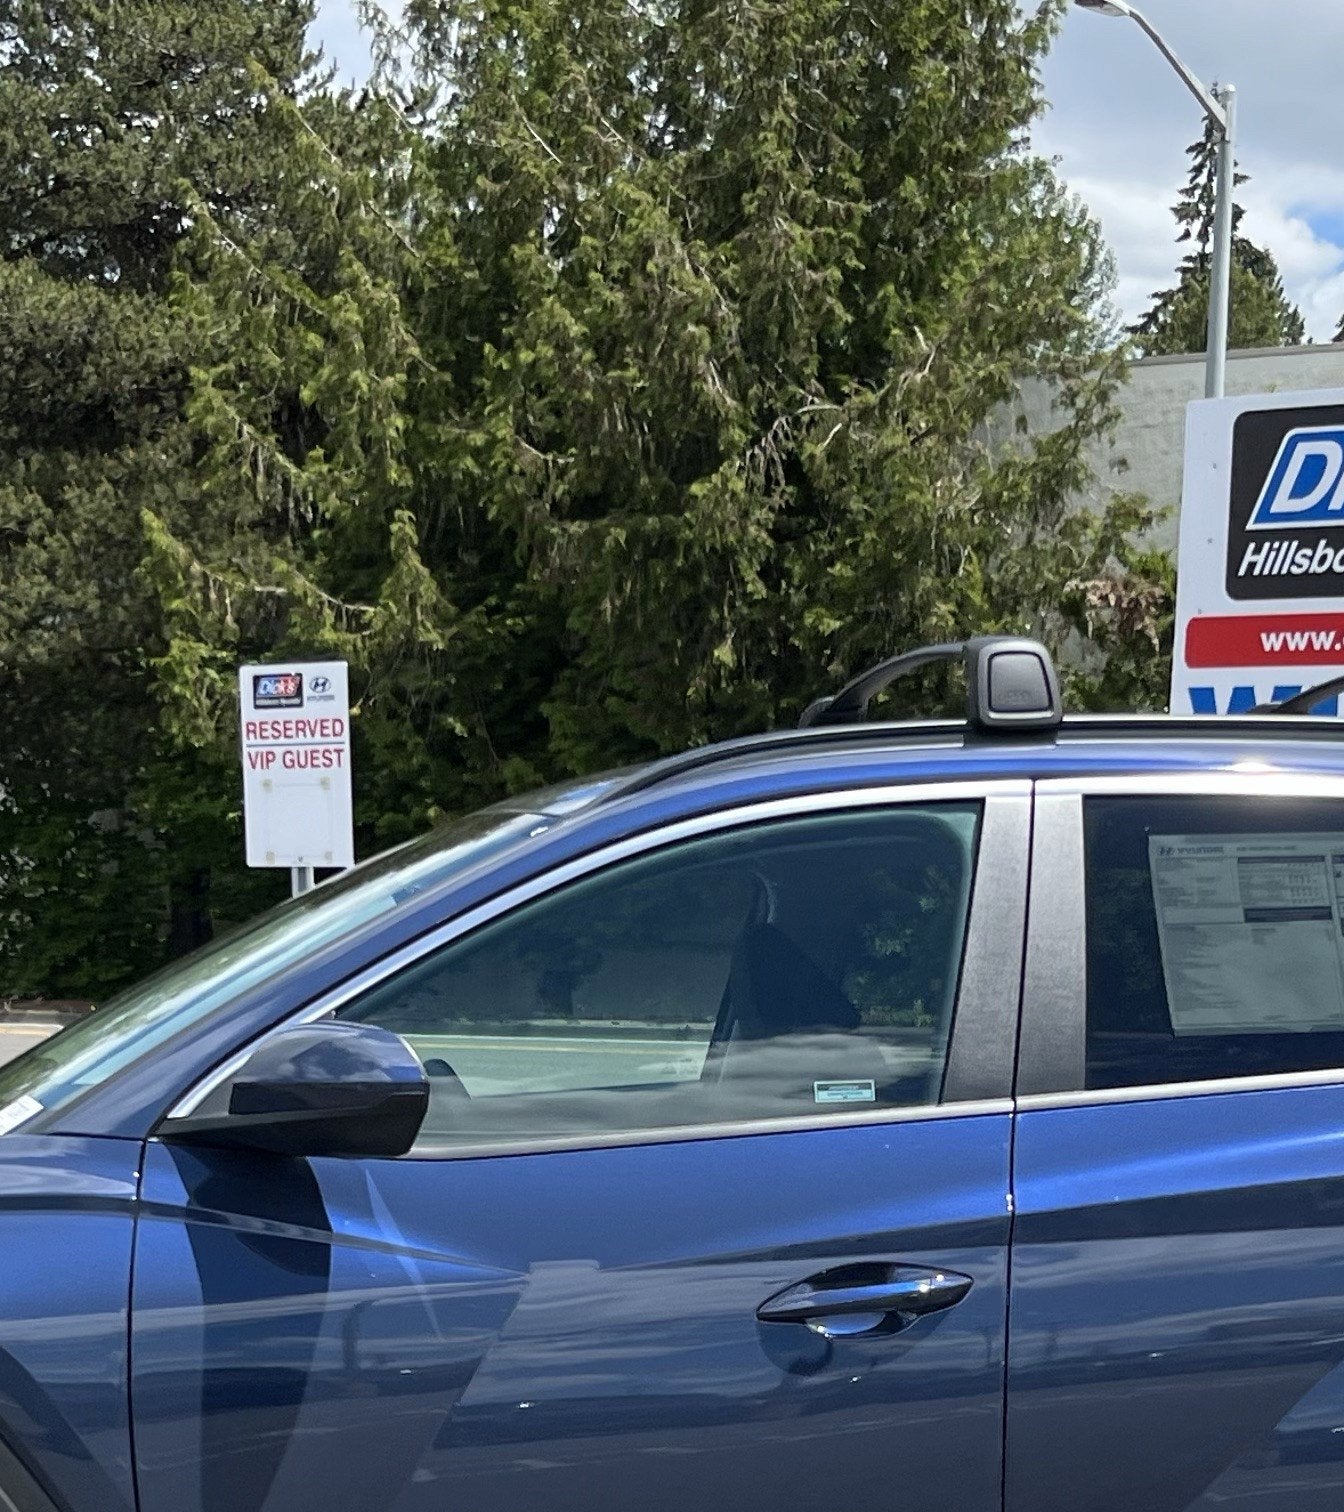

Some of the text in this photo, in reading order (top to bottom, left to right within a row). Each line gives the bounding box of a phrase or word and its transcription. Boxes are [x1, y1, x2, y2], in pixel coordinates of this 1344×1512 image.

[246, 719, 345, 740] RESERVED
[247, 748, 345, 770] VIP GUEST
